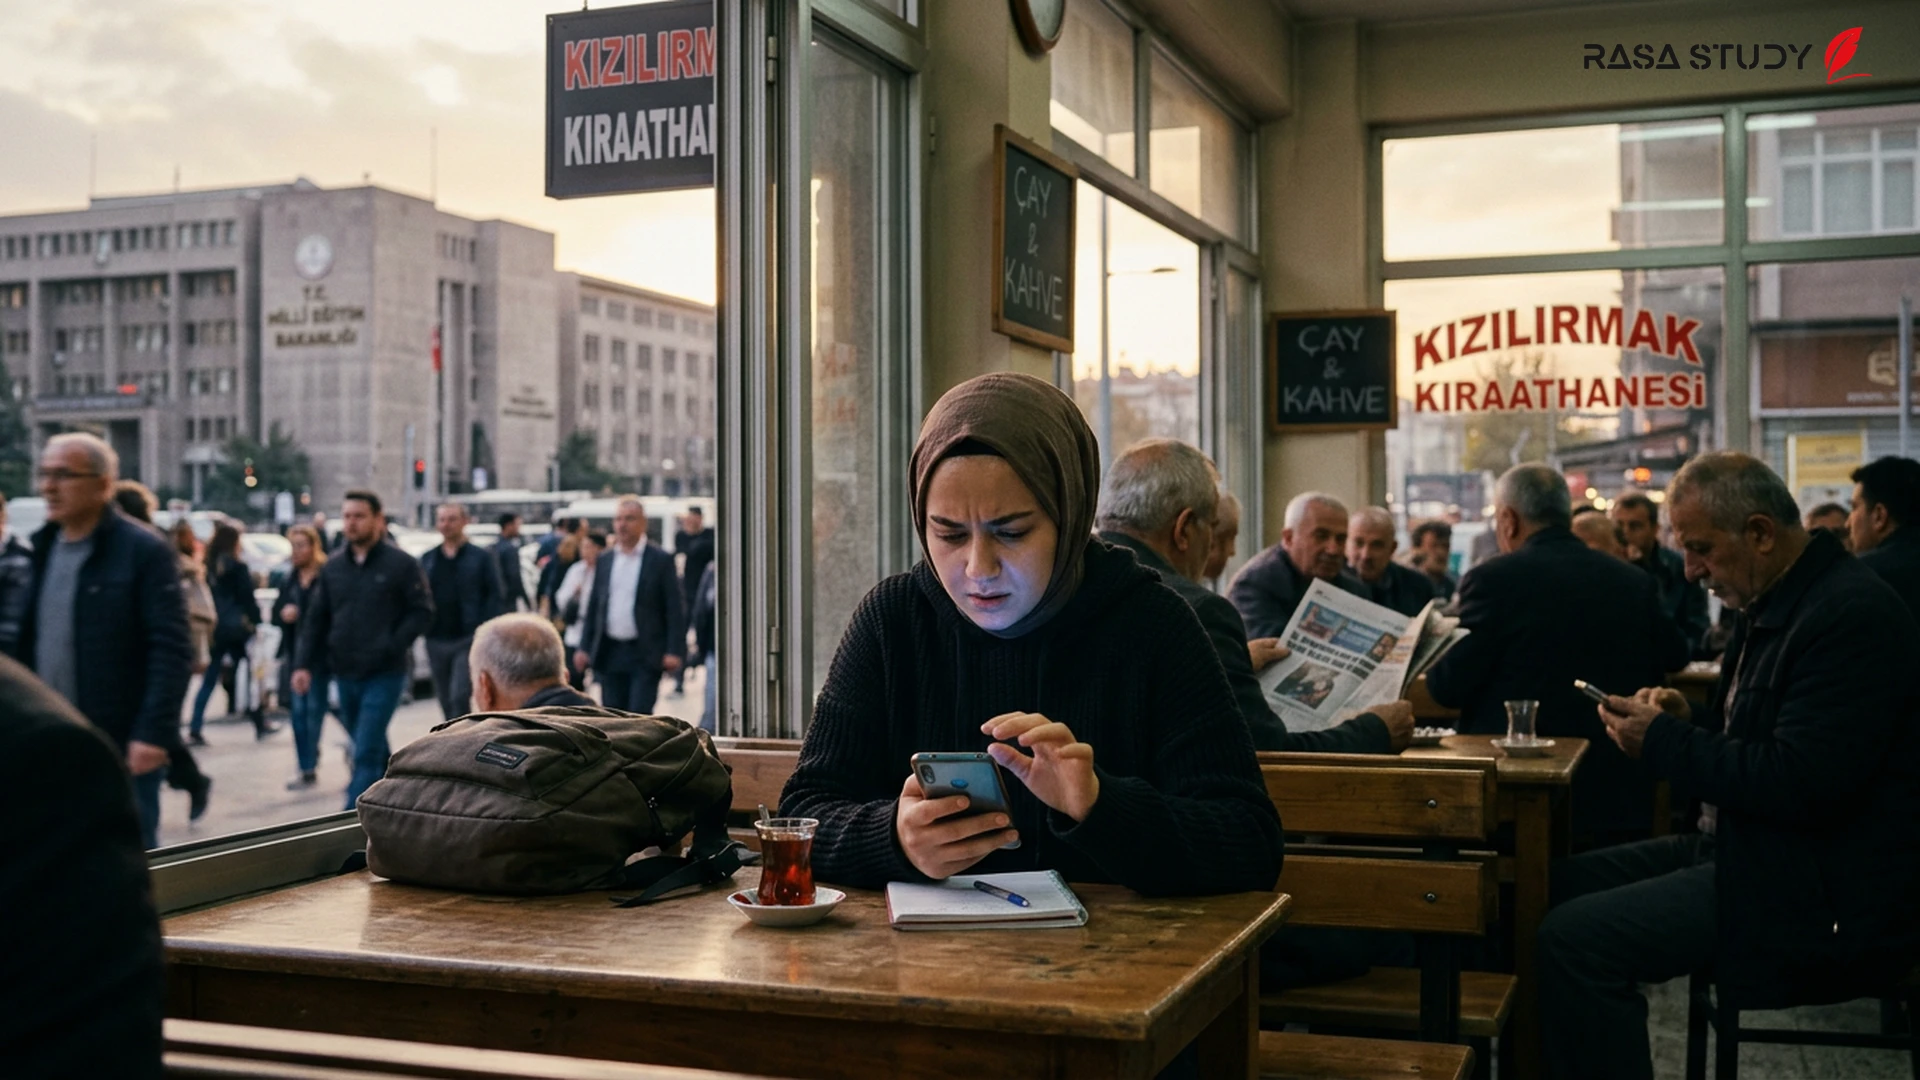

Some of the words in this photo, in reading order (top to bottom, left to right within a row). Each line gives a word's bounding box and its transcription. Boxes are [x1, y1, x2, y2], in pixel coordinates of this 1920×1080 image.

[1013, 165, 1052, 219] ÇAY
[1027, 222, 1039, 257] &
[1004, 256, 1063, 321] KAHVE
[1298, 324, 1365, 358] ÇAY
[1413, 305, 1703, 371] KIZILIRMAK
[1323, 356, 1344, 380] &
[1283, 384, 1385, 415] KAHVE
